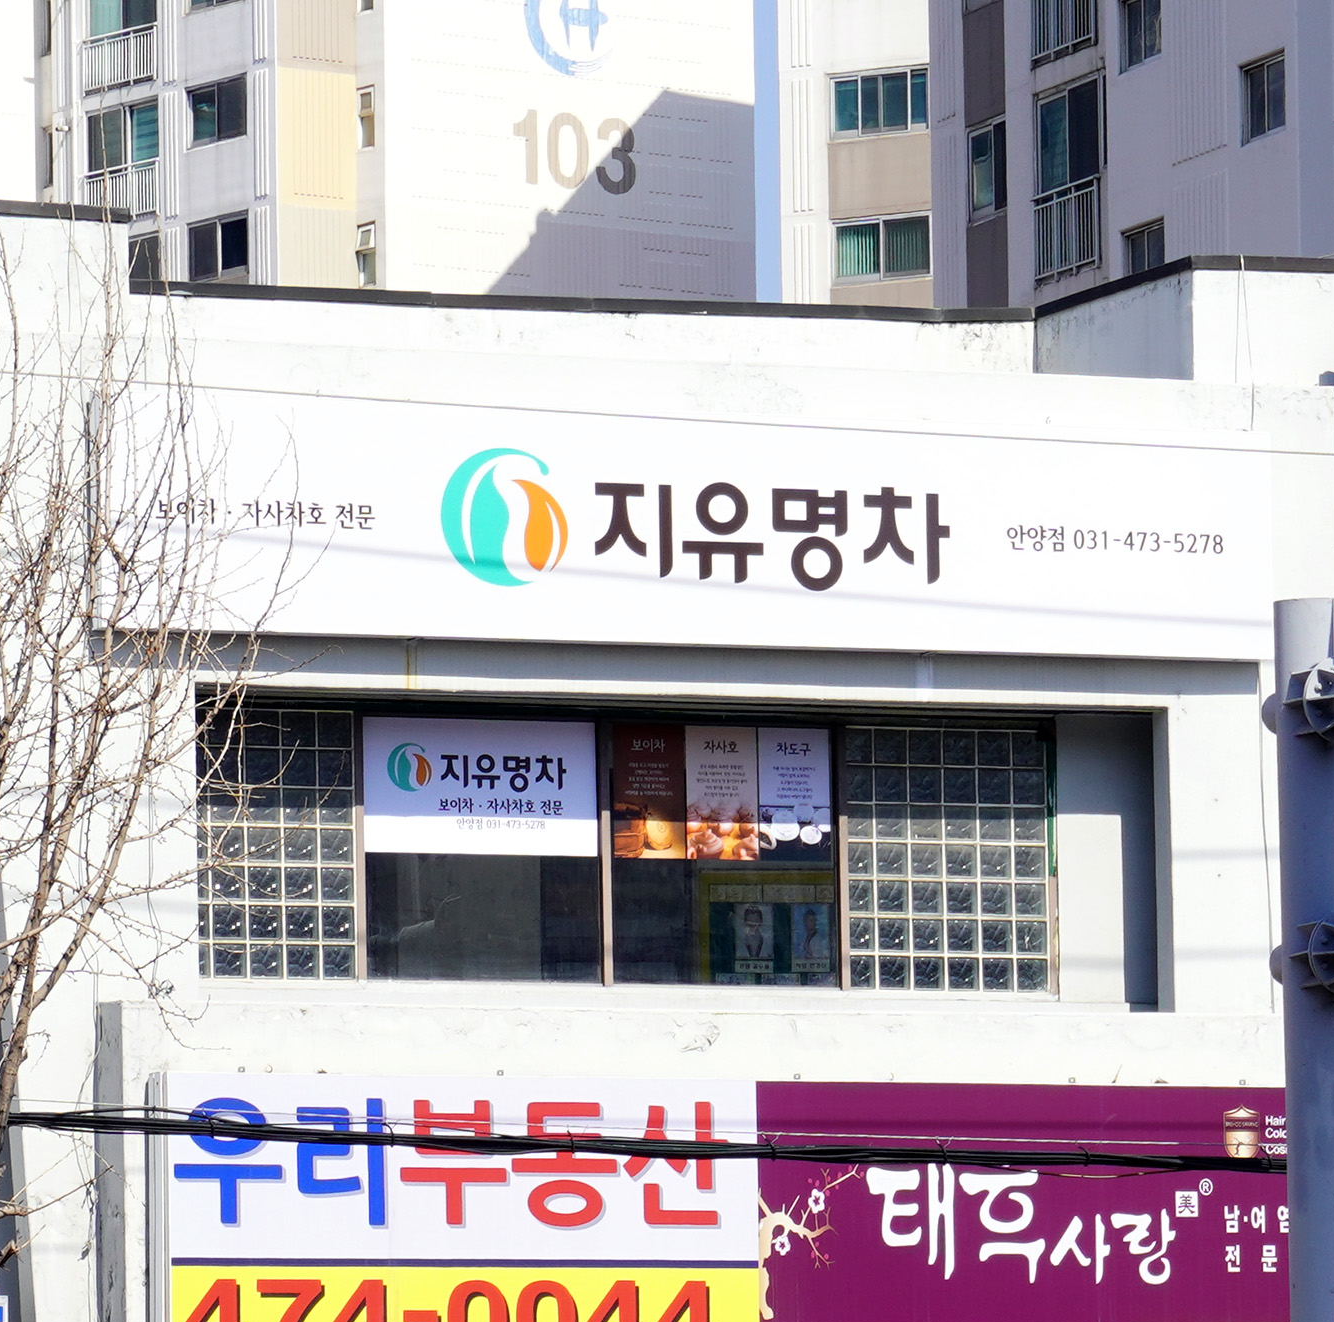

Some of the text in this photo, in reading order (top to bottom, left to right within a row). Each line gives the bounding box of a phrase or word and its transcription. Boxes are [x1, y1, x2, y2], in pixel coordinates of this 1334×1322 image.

[514, 109, 635, 195] 103
[155, 500, 375, 530] 보이차 자사차호 전문
[594, 482, 950, 592] 지유명차
[1007, 526, 1224, 555] 안양점 031-473-5278
[632, 739, 665, 752] 보이차
[703, 740, 739, 753] 자사호
[776, 743, 811, 756] 차도구
[440, 754, 566, 791] 지유명차
[439, 798, 563, 815] 보이차 자사차호 전문
[456, 818, 545, 830] 안양점 031-473-5278
[1265, 1116, 1286, 1126] Hair
[1224, 1205, 1266, 1233] 남·여
[1225, 1245, 1278, 1273] 전문
